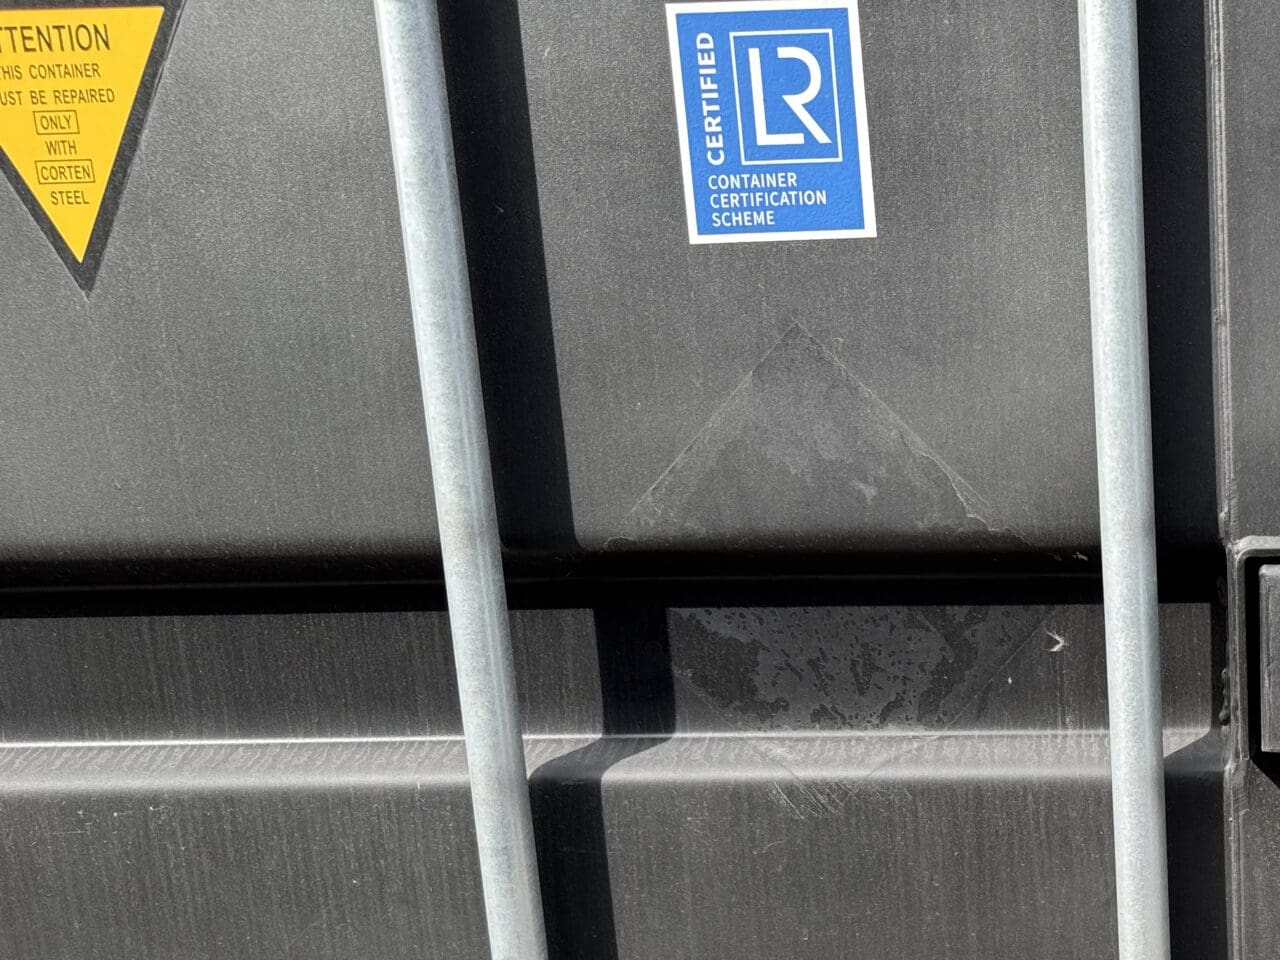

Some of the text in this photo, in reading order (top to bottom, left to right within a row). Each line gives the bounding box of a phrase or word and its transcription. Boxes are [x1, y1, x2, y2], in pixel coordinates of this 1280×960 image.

[29, 63, 101, 80] CONTAINER
[31, 90, 47, 105] BE
[54, 88, 115, 104] REPAIRED
[696, 32, 725, 166] CERTIFIED
[748, 46, 832, 146] LR
[40, 115, 71, 130] ONLY
[45, 140, 77, 155] WITH
[40, 165, 91, 181] CORTEN
[708, 172, 798, 189] CONTAINER
[50, 190, 89, 206] STEEL
[710, 190, 827, 208] CERTIFICATION
[712, 210, 775, 227] SCHEME
